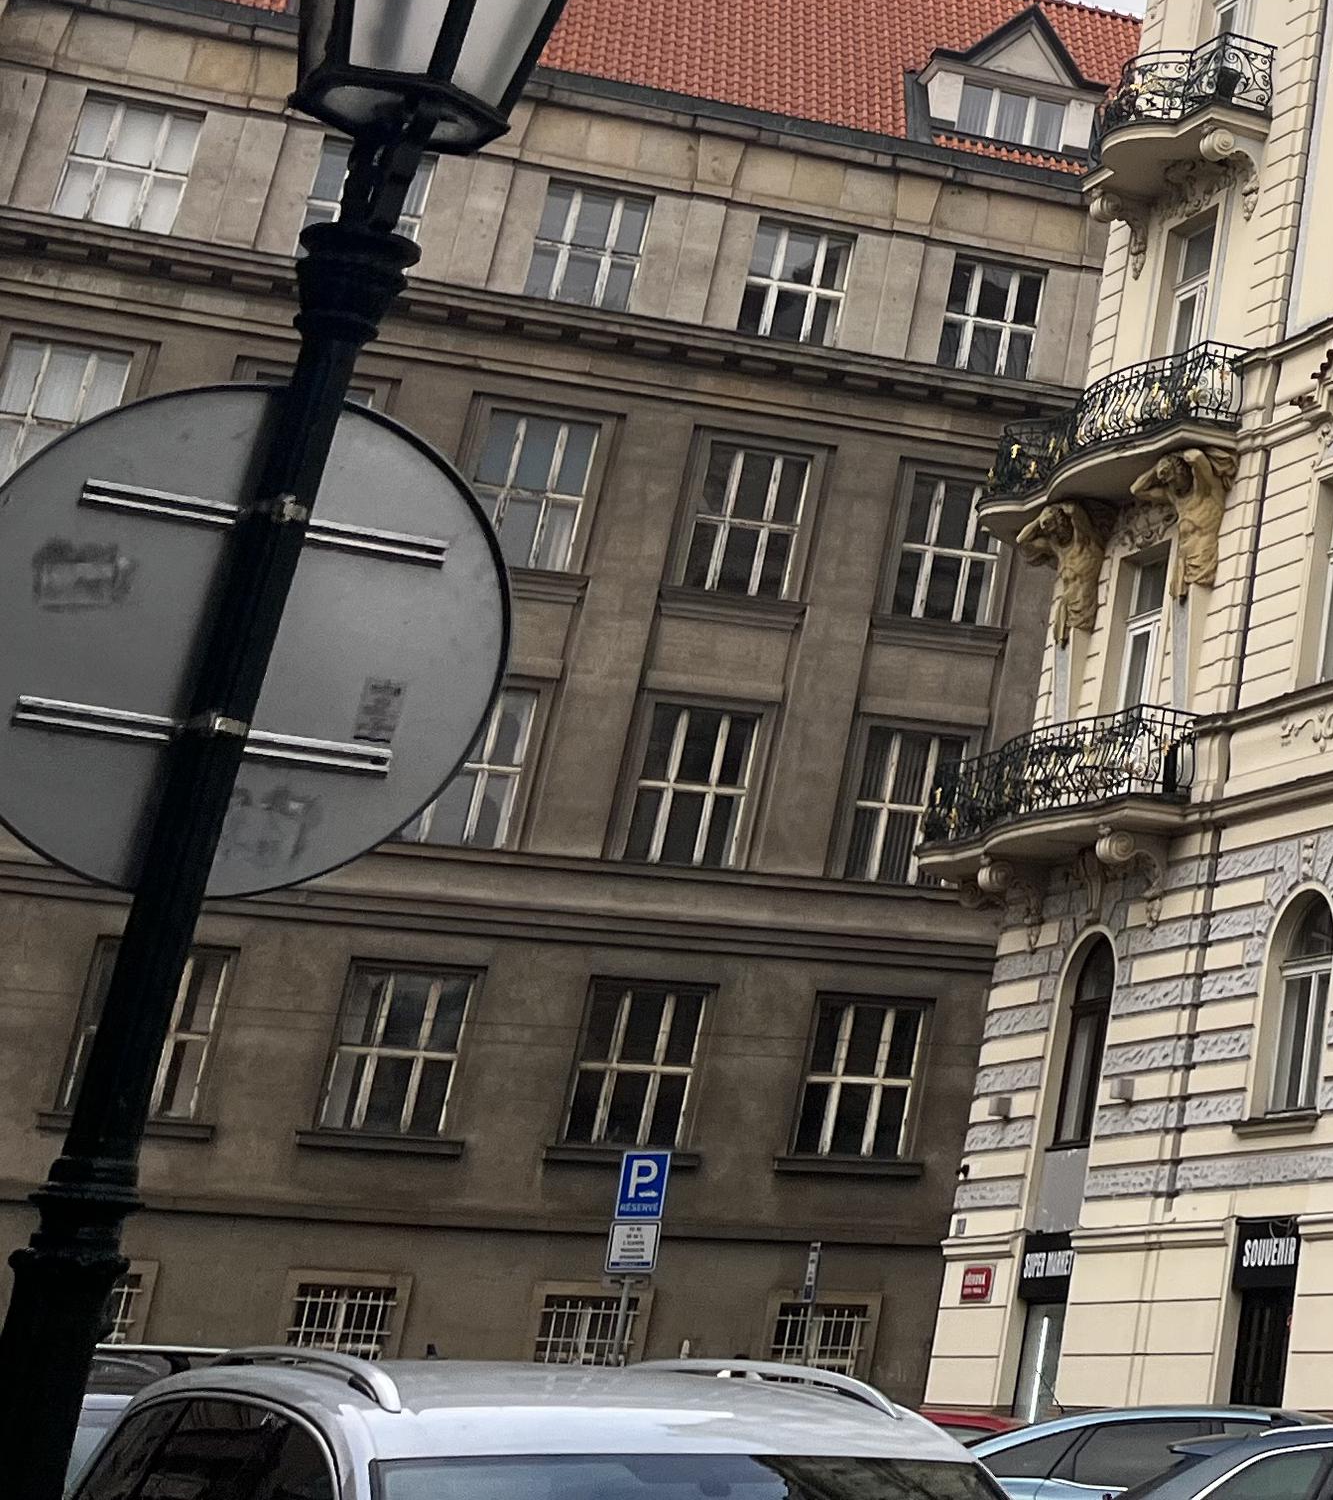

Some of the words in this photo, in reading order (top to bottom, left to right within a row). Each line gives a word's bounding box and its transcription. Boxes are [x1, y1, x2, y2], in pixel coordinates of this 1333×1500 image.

[627, 1159, 659, 1199] P
[1023, 1252, 1047, 1279] SUPER
[1242, 1237, 1297, 1268] SOUVENIR
